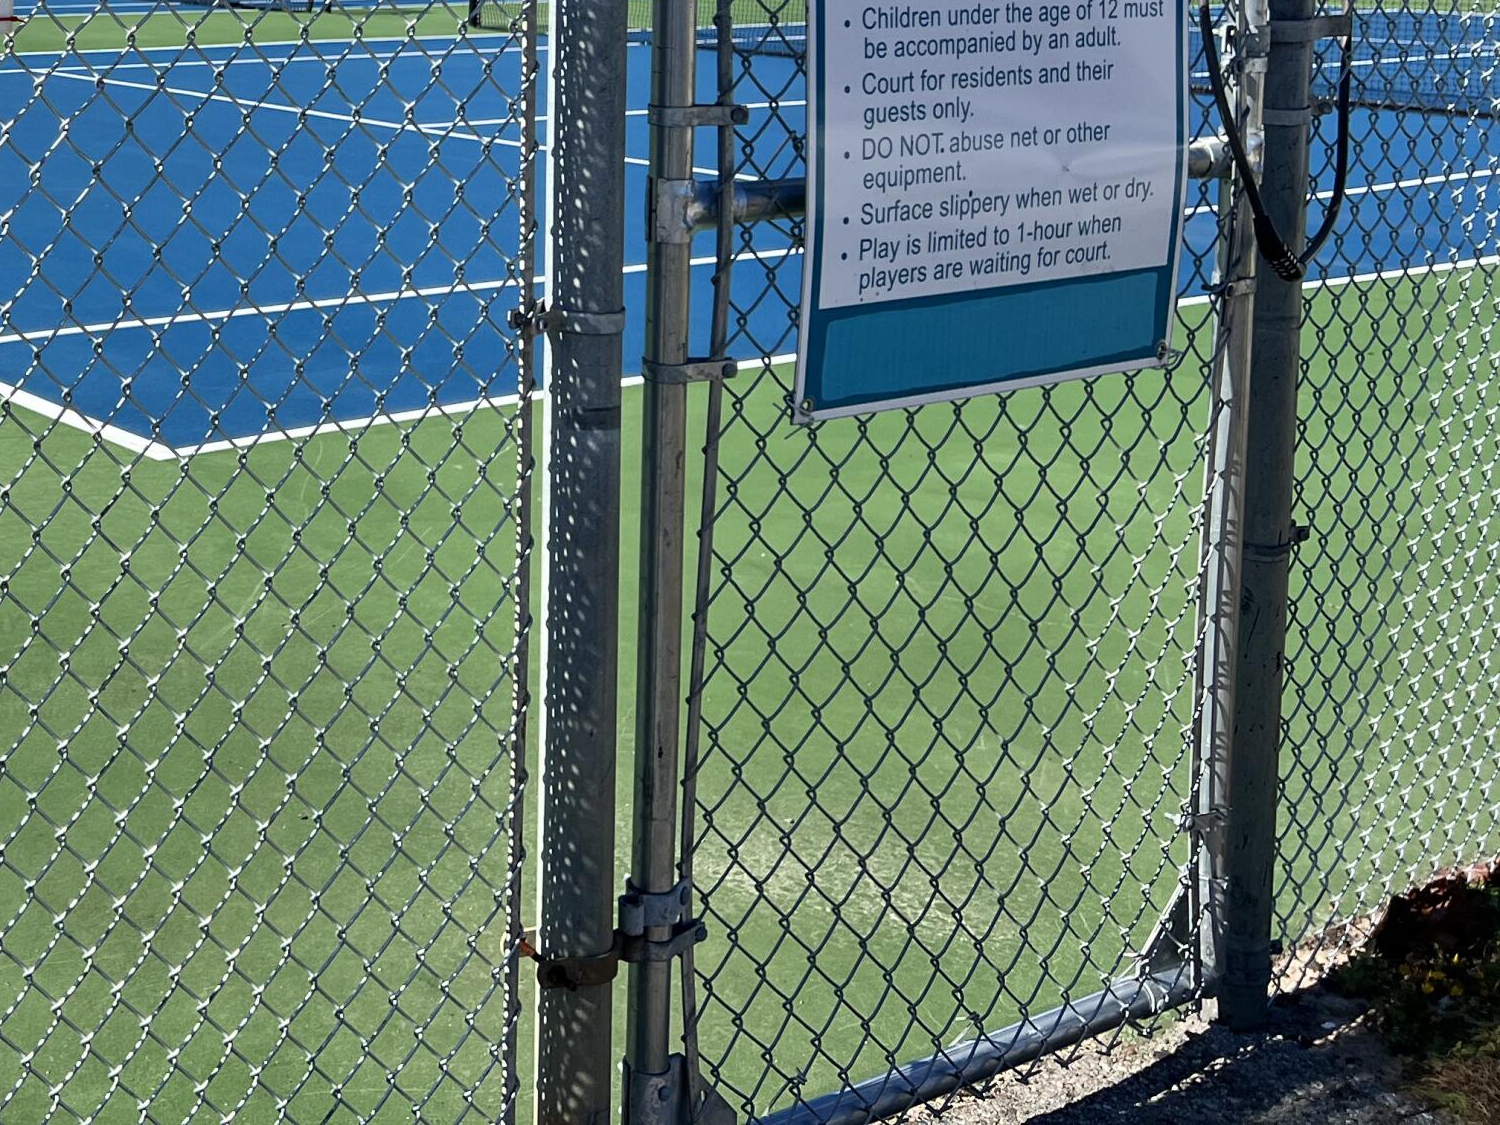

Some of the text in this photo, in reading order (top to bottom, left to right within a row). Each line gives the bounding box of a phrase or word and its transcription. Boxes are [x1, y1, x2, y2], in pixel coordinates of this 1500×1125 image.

[862, 7, 941, 30] Children
[948, 4, 999, 27] under
[1006, 2, 1031, 24] the
[1039, 6, 1070, 28] age
[1076, 0, 1092, 20] of
[1099, 0, 1118, 19] 12
[864, 26, 1121, 60] be accompanied by an adult.
[862, 60, 1114, 95] Court for residents and their
[864, 97, 974, 129] guests only.
[862, 136, 893, 161] DO
[950, 130, 1004, 153] abuse
[1010, 128, 1037, 148] net
[1044, 126, 1061, 145] or
[1067, 122, 1110, 143] other
[863, 161, 966, 193] equipment.
[861, 177, 1154, 225] Surface slippery when wet or dry.
[859, 215, 1121, 263] Play is limited to 1-hour when
[859, 241, 1111, 294] players are waiting for court.
